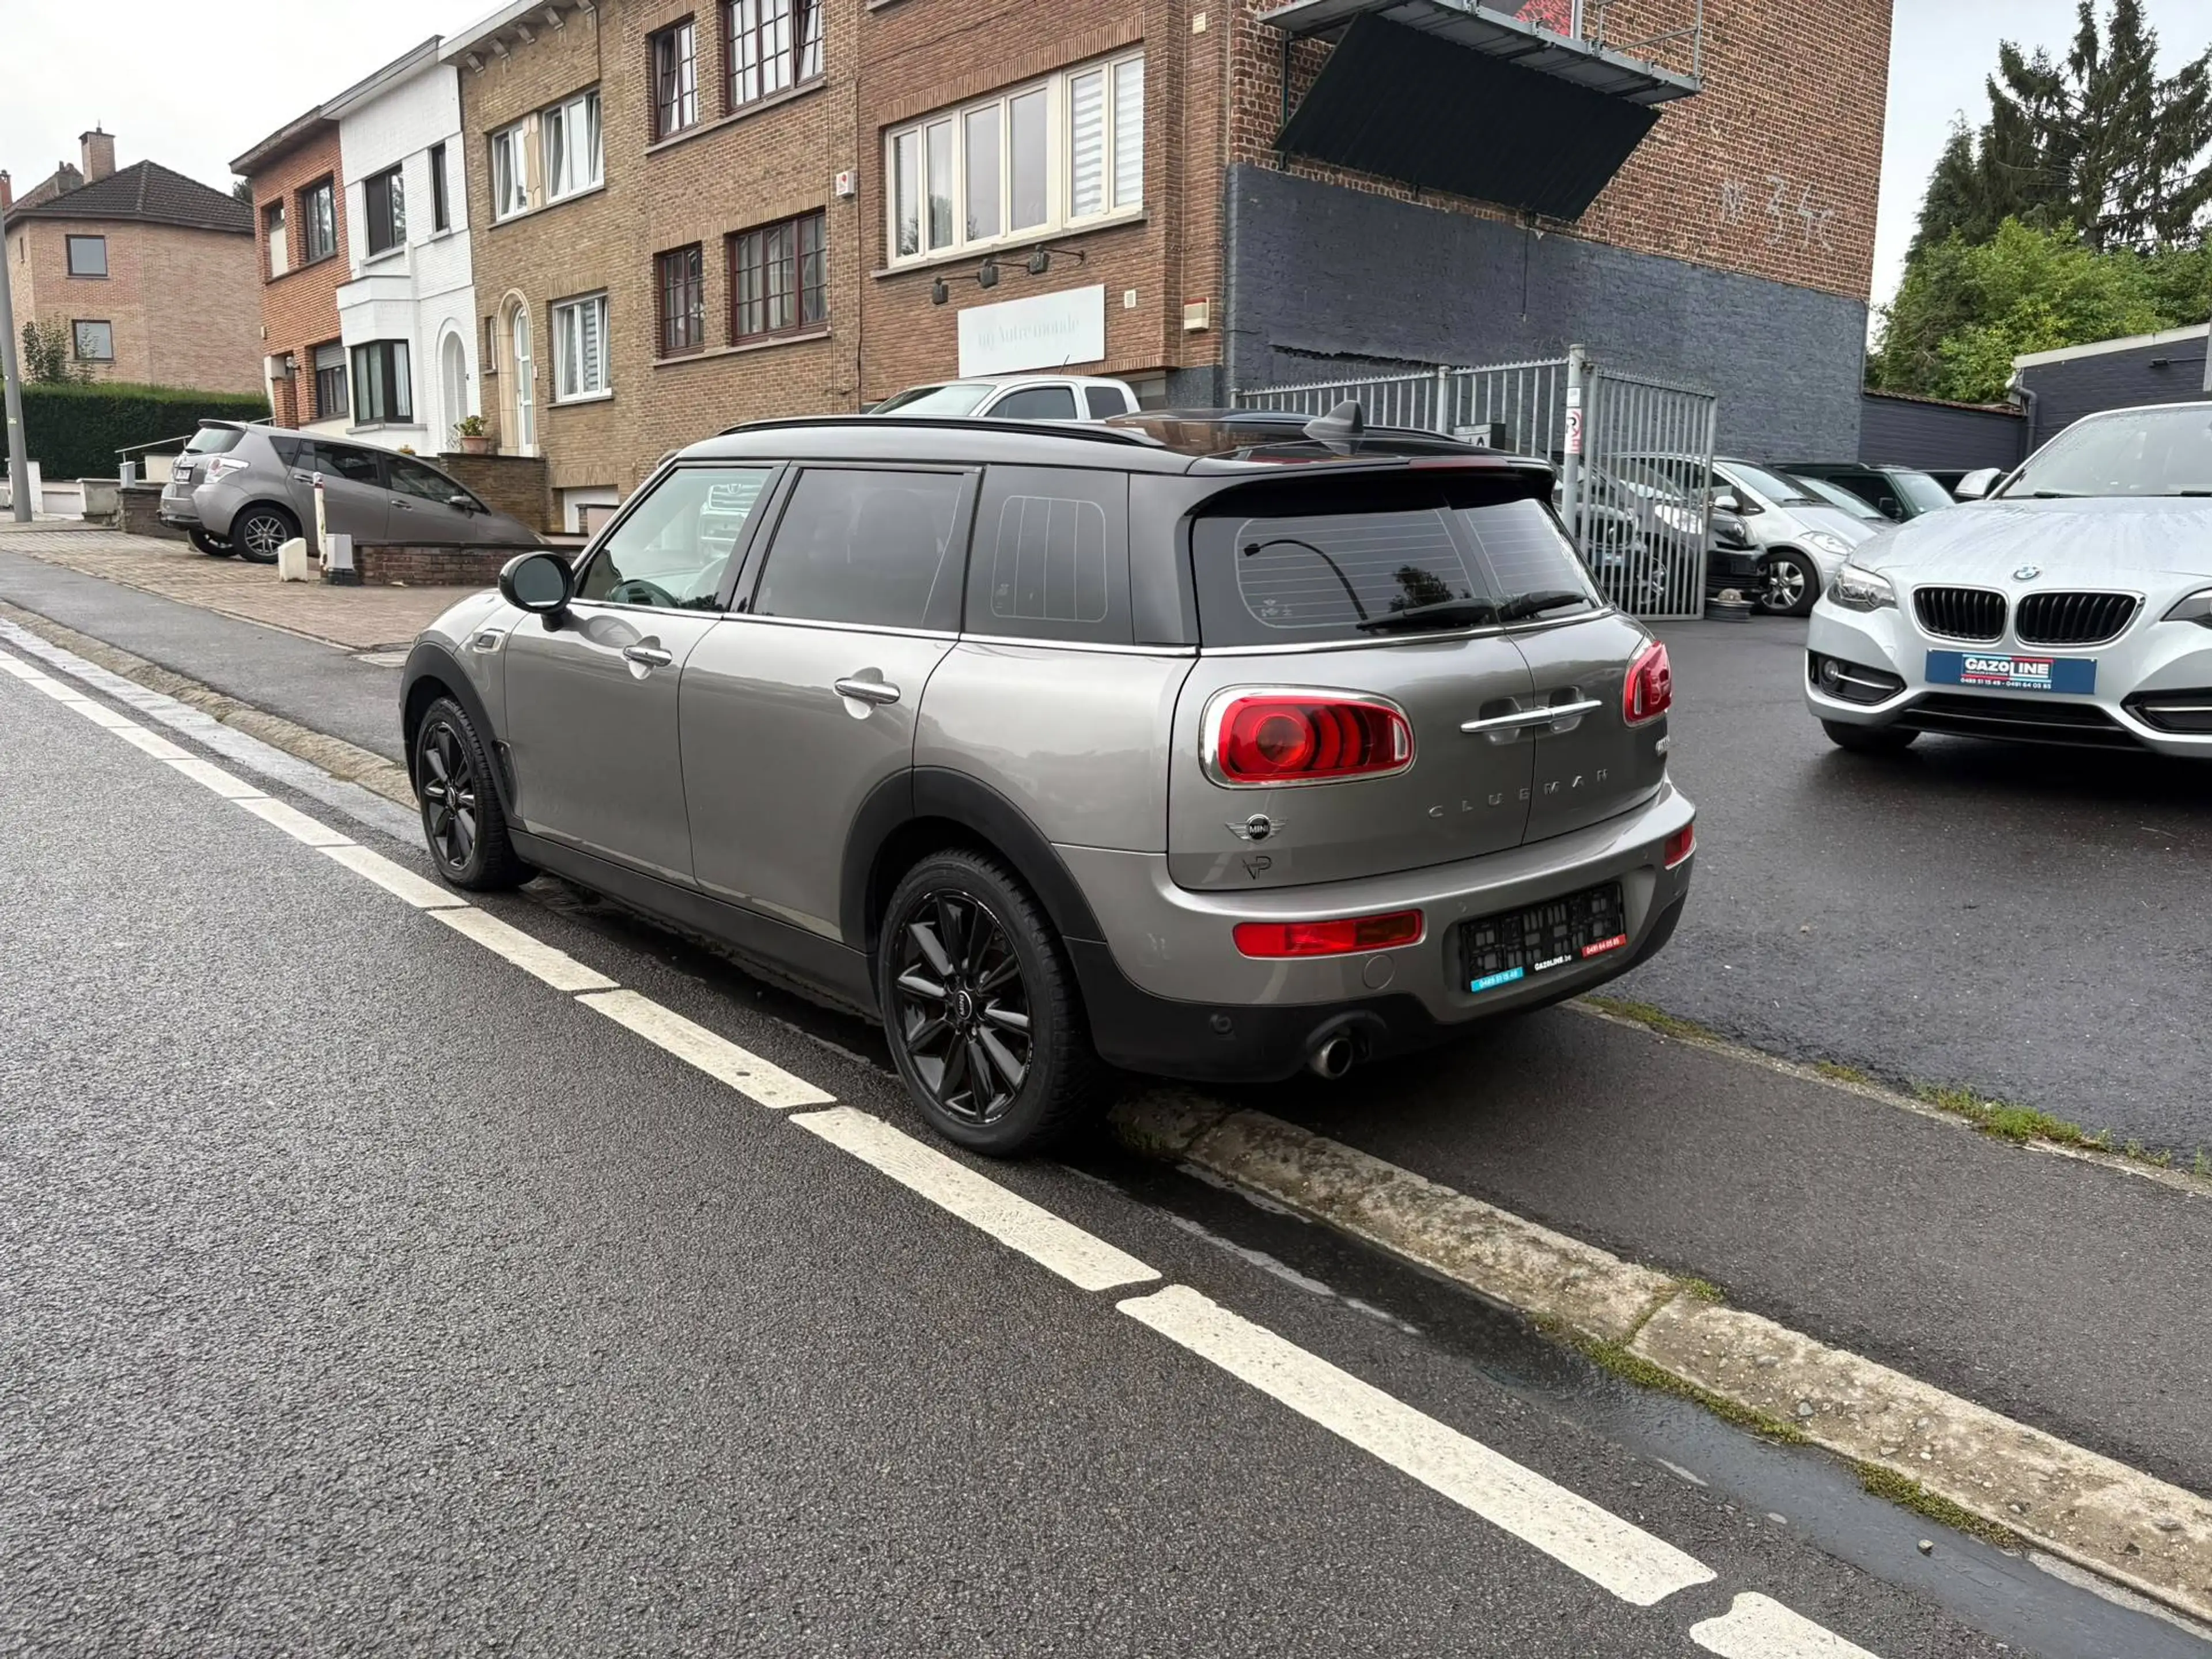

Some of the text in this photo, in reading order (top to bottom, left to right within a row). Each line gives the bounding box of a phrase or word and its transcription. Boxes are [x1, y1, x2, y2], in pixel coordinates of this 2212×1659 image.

[1965, 657, 2050, 679] GAZOLINE
[1427, 768, 1609, 818] CLUBMAN
[1249, 825, 1270, 834] MINI
